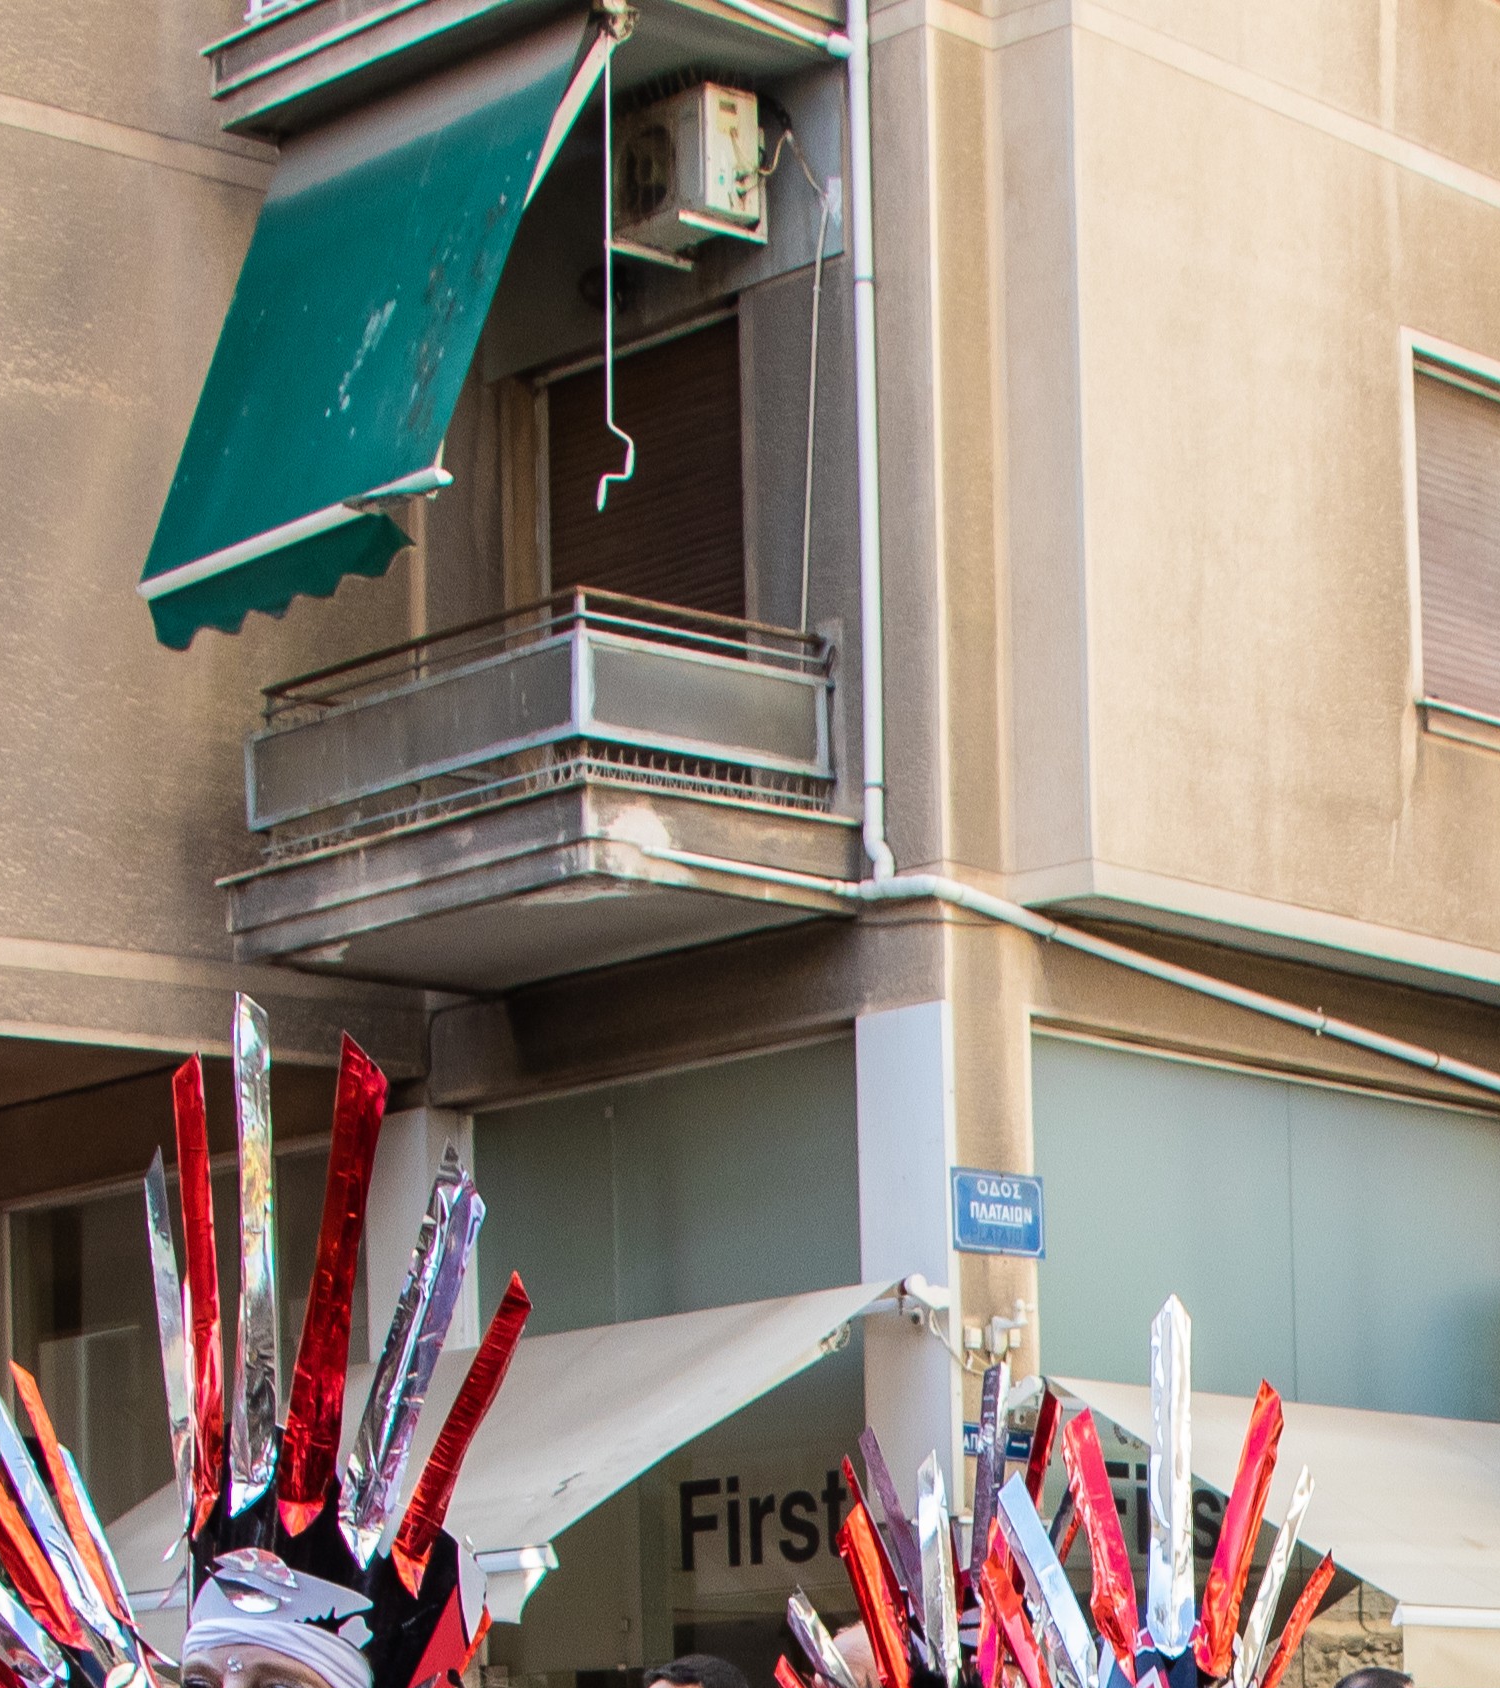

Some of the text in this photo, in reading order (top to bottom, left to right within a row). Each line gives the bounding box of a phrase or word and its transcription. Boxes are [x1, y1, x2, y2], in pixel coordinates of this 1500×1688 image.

[977, 1179, 1021, 1199] ΟΔΟΣ
[969, 1200, 1033, 1224] ΠΛΑΤΑΙΩΝ
[679, 1469, 848, 1573] First
